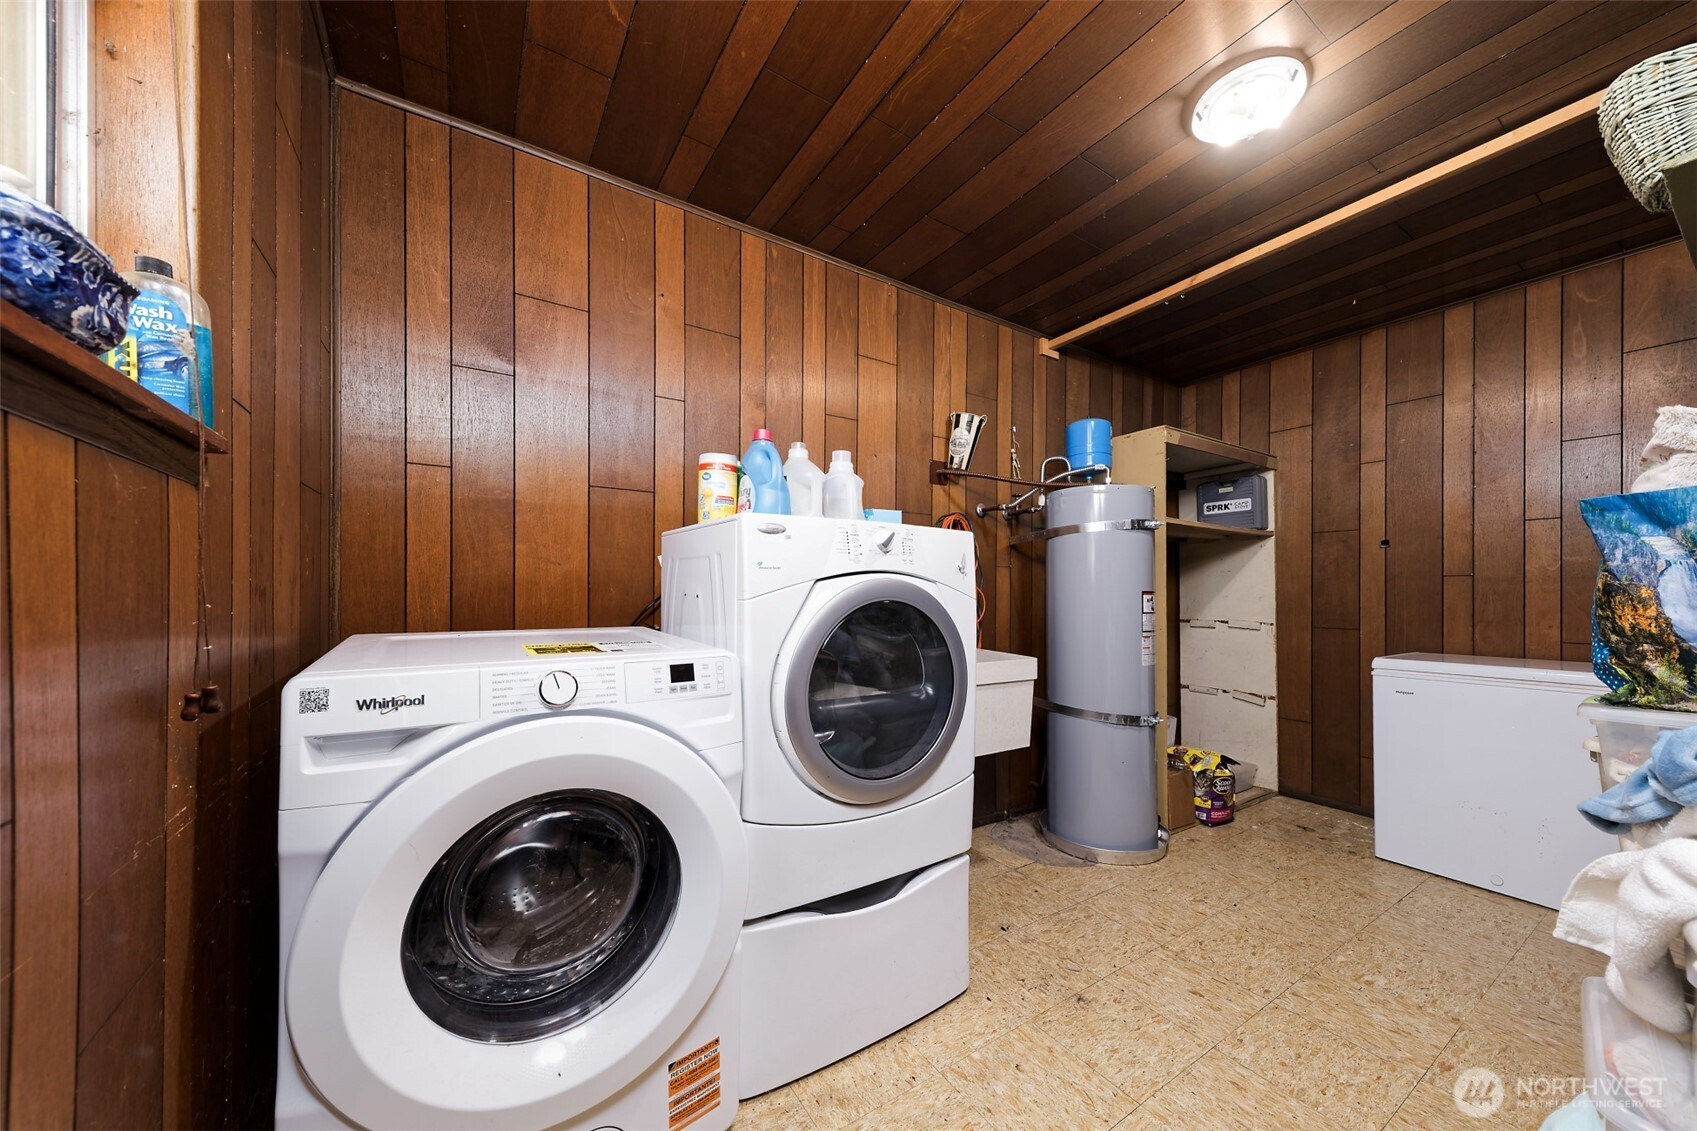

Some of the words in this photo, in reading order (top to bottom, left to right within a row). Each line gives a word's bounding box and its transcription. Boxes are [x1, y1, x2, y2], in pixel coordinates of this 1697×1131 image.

[132, 315, 178, 333] Wax
[356, 695, 425, 711] Whirlpool
[671, 1056, 703, 1079] REGISTER
[704, 1047, 719, 1060] NOW
[670, 1075, 684, 1086] CALL
